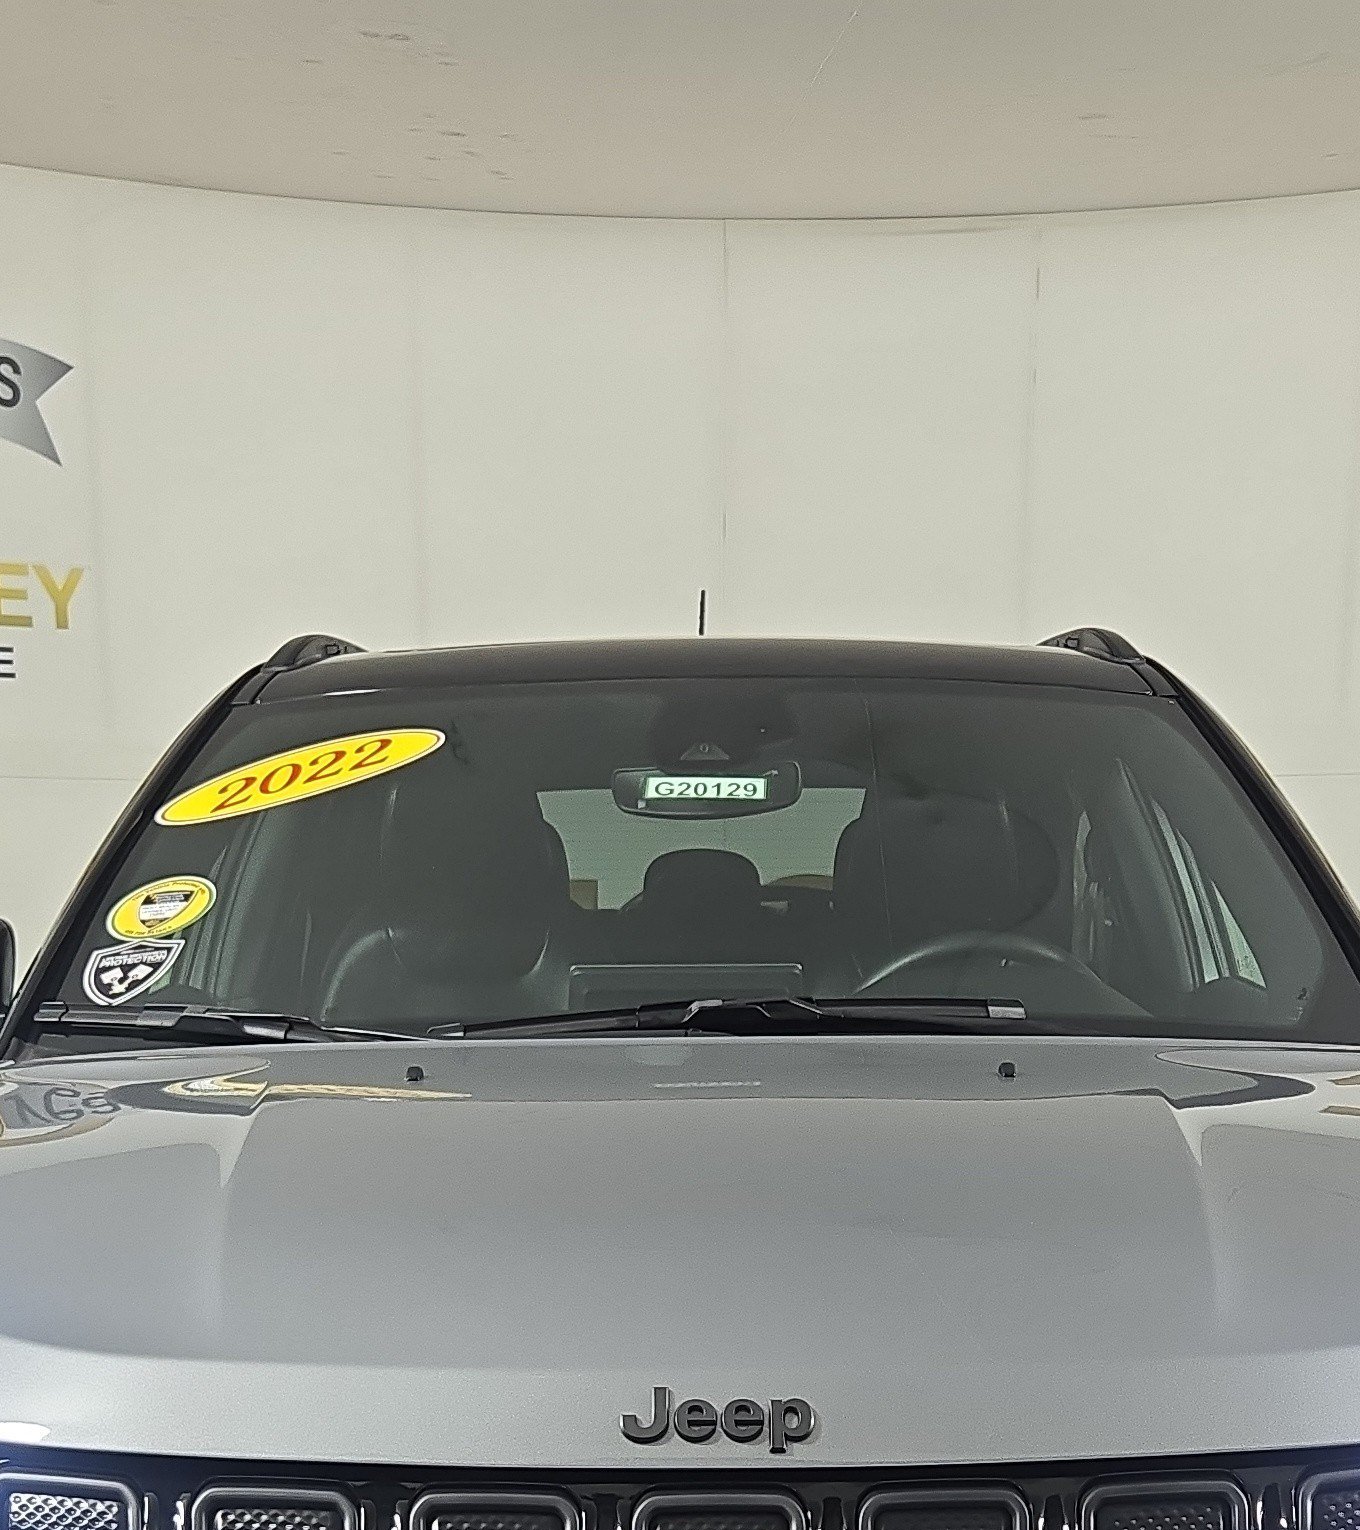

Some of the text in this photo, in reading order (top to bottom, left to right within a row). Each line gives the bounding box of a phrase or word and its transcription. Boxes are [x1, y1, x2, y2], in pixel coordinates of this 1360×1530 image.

[209, 737, 393, 814] 2022
[654, 781, 759, 798] G20129
[619, 1386, 816, 1454] Jeep
